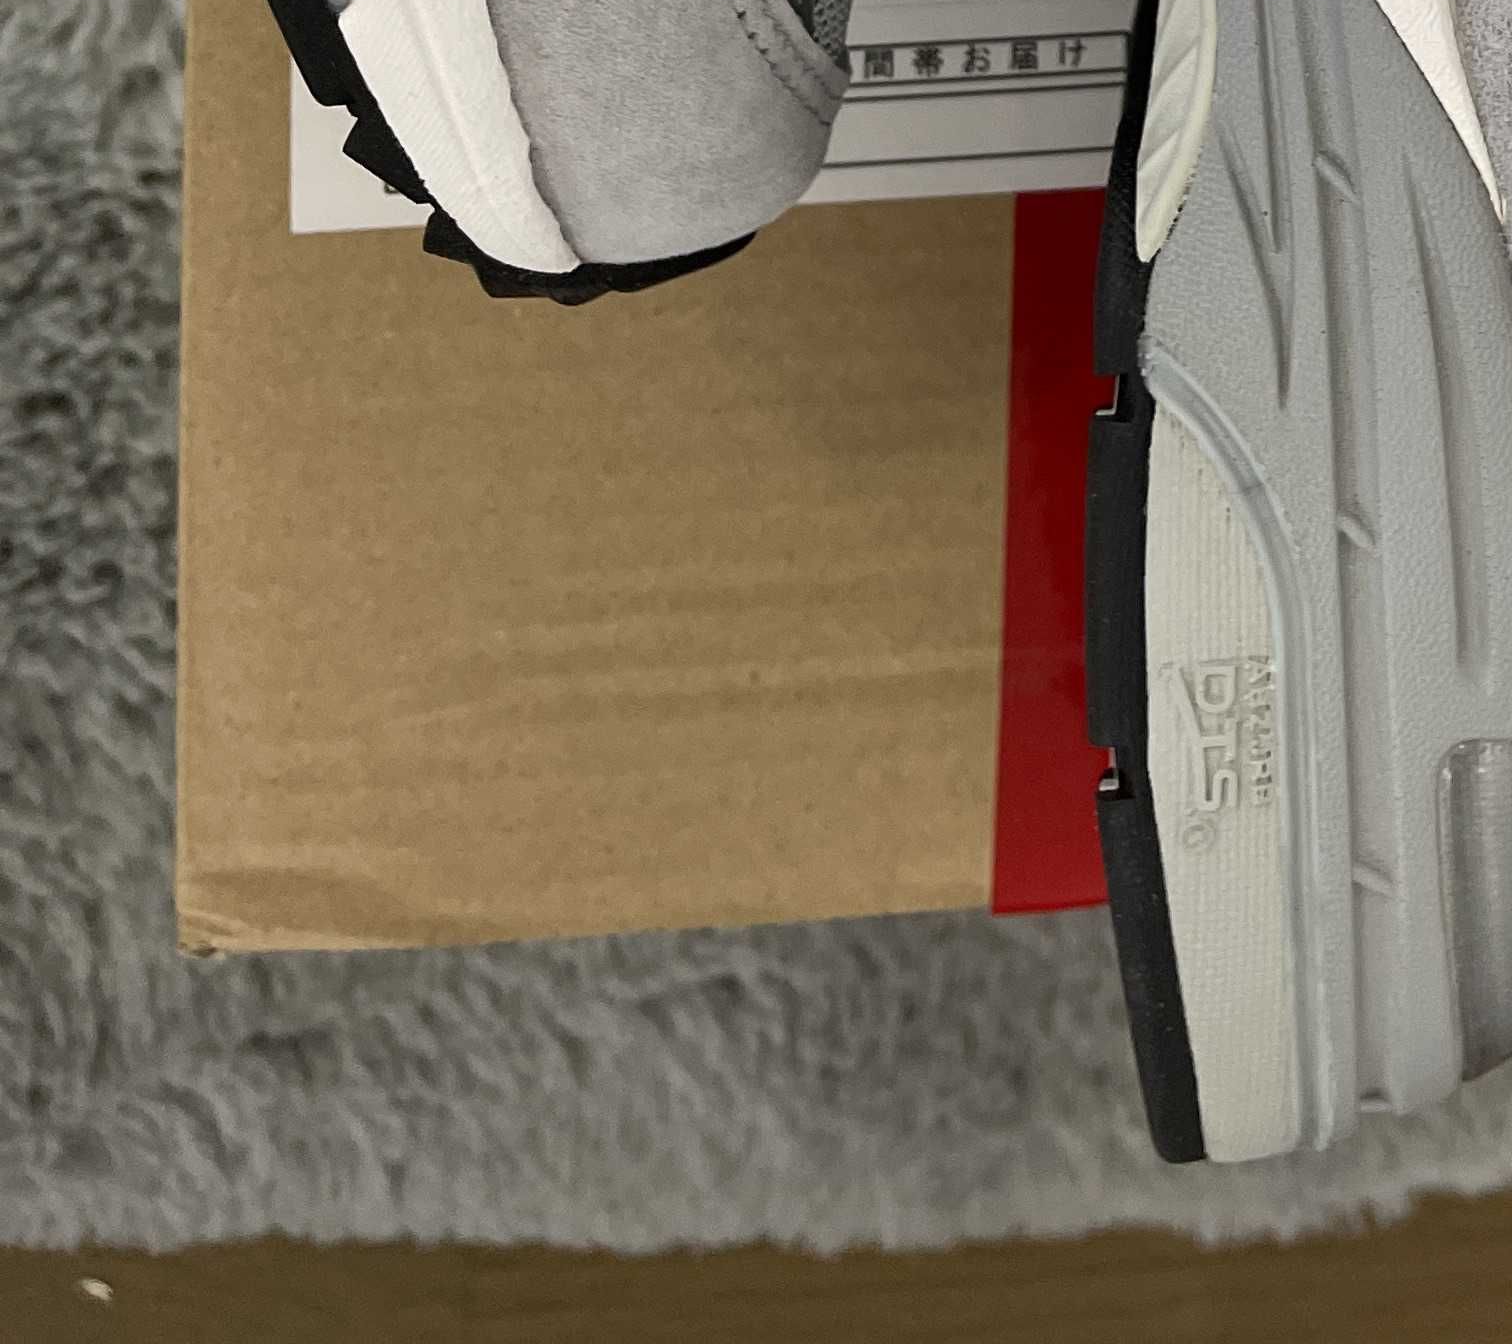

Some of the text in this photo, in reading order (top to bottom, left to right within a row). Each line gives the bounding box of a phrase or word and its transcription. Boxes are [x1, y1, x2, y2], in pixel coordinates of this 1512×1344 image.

[852, 38, 1086, 80] 間帯お届け
[1199, 664, 1240, 813] DTS
